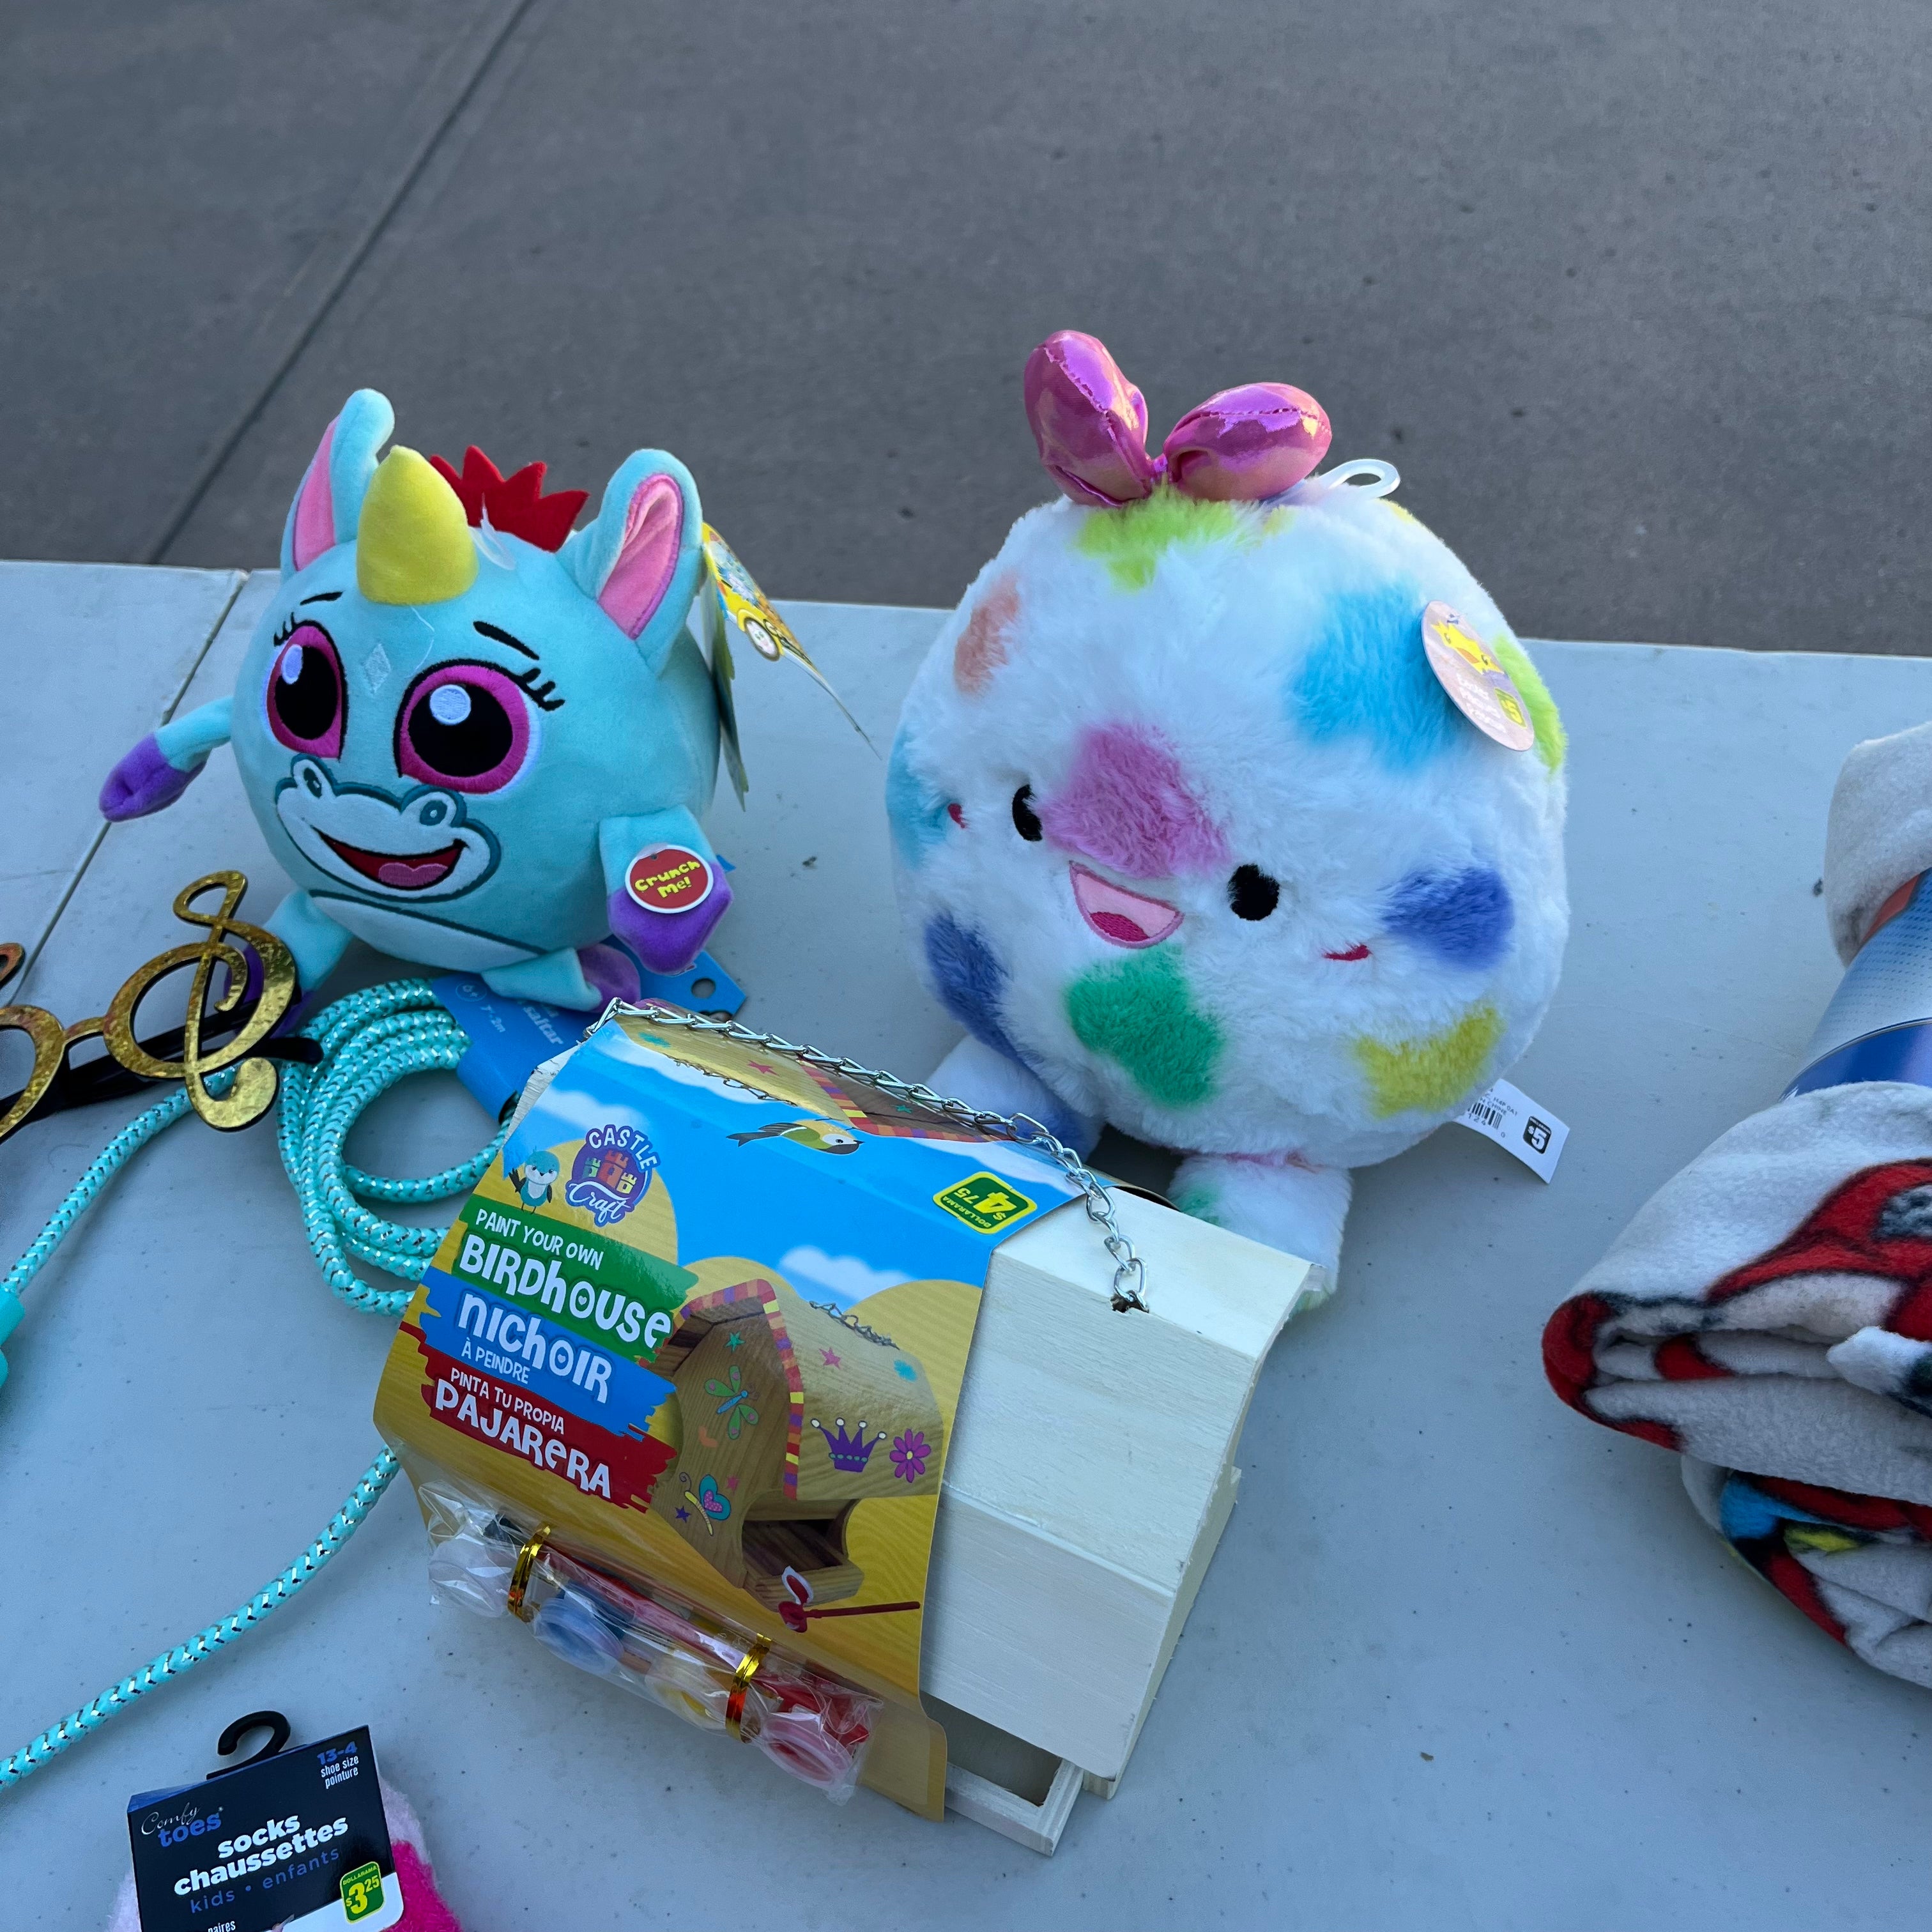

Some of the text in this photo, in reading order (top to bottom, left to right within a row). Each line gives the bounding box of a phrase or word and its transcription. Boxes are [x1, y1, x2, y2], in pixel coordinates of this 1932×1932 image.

[634, 861, 700, 891] Crunch
[589, 1128, 657, 1170] CASTLE
[1528, 1125, 1547, 1151] $5
[569, 1181, 631, 1223] Craft
[942, 1196, 992, 1228] DOLLARAMA
[476, 1208, 604, 1270] PAINT YOUR OWN
[473, 1346, 530, 1384] PEINDRE
[450, 1367, 565, 1435] PINTA TU PROPIA
[317, 1741, 357, 1765] 13-4
[321, 1755, 359, 1778] shoe size
[325, 1766, 358, 1789] pointure
[141, 1802, 201, 1835] Comfy
[158, 1812, 221, 1847] toes
[218, 1813, 300, 1859] socks
[174, 1816, 348, 1896] chaussettes
[190, 1848, 339, 1913] kids enfants
